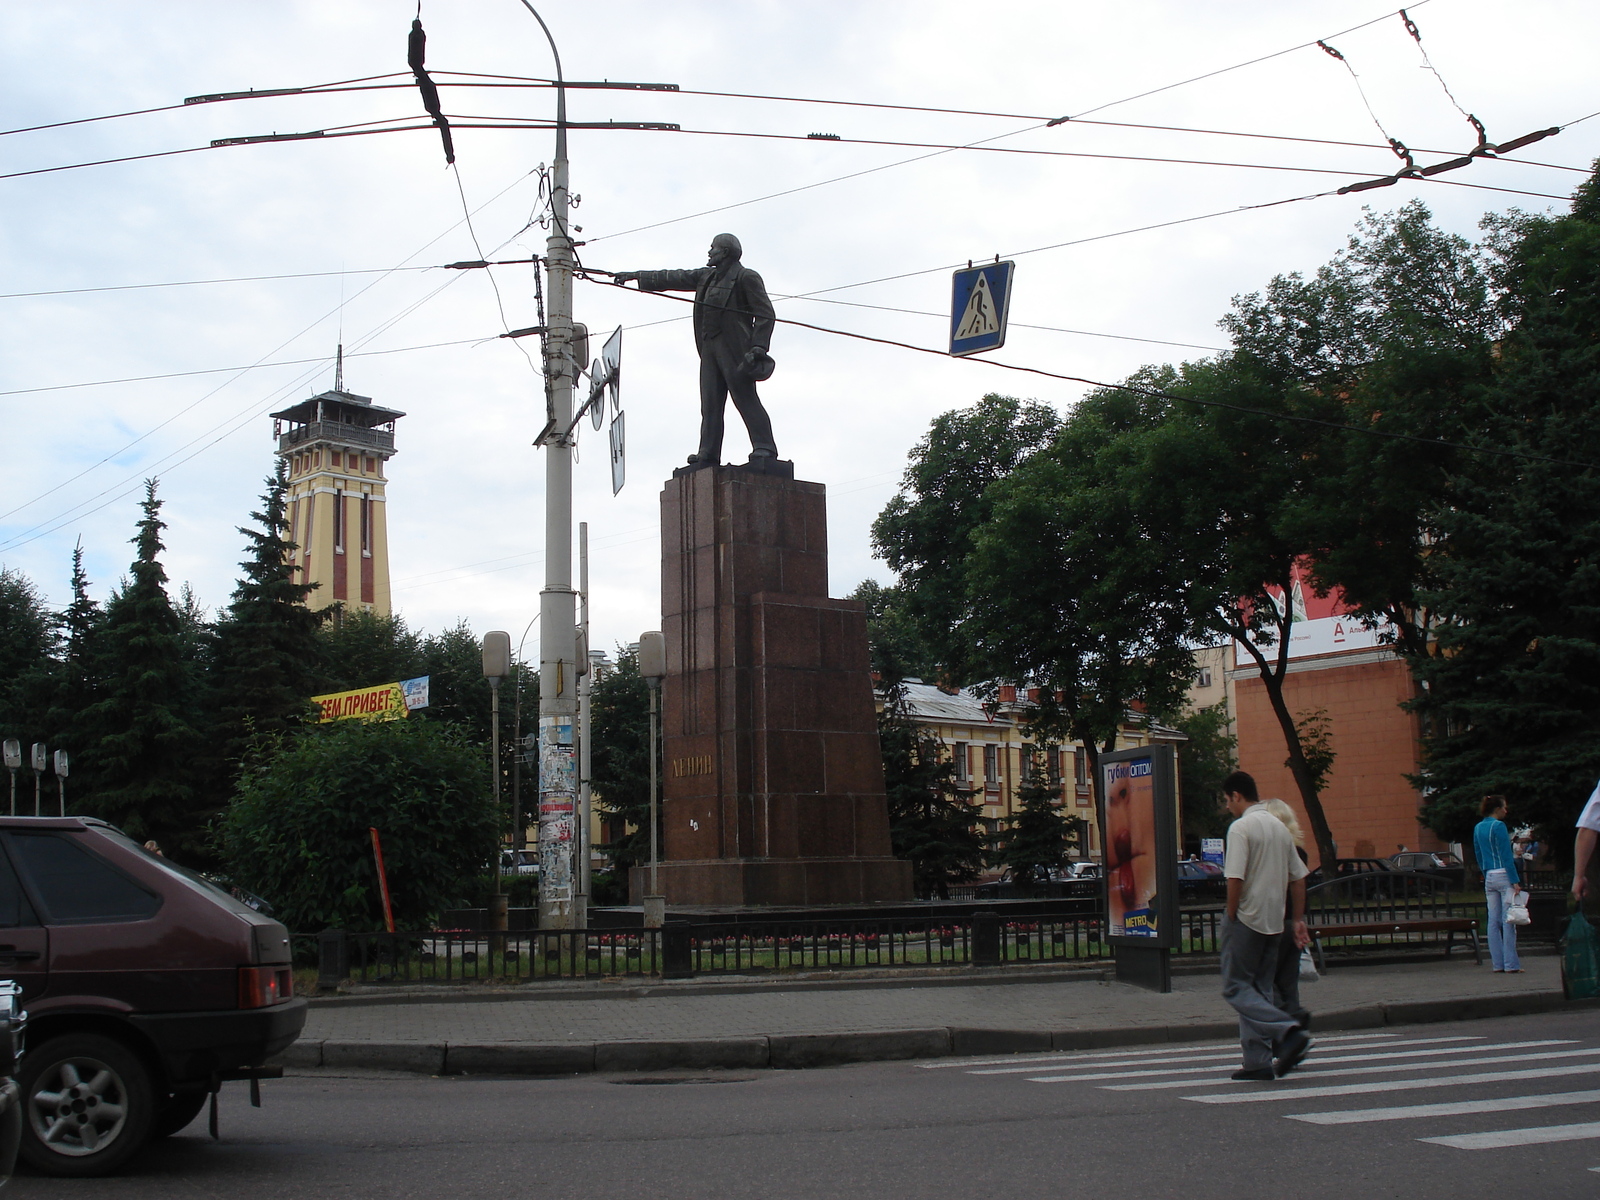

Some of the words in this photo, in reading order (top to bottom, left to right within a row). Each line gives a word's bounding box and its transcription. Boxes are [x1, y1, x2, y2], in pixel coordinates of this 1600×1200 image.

[315, 697, 341, 719] СЕМ
[672, 754, 712, 778] ЛЕНИН
[1125, 915, 1147, 928] METRO
